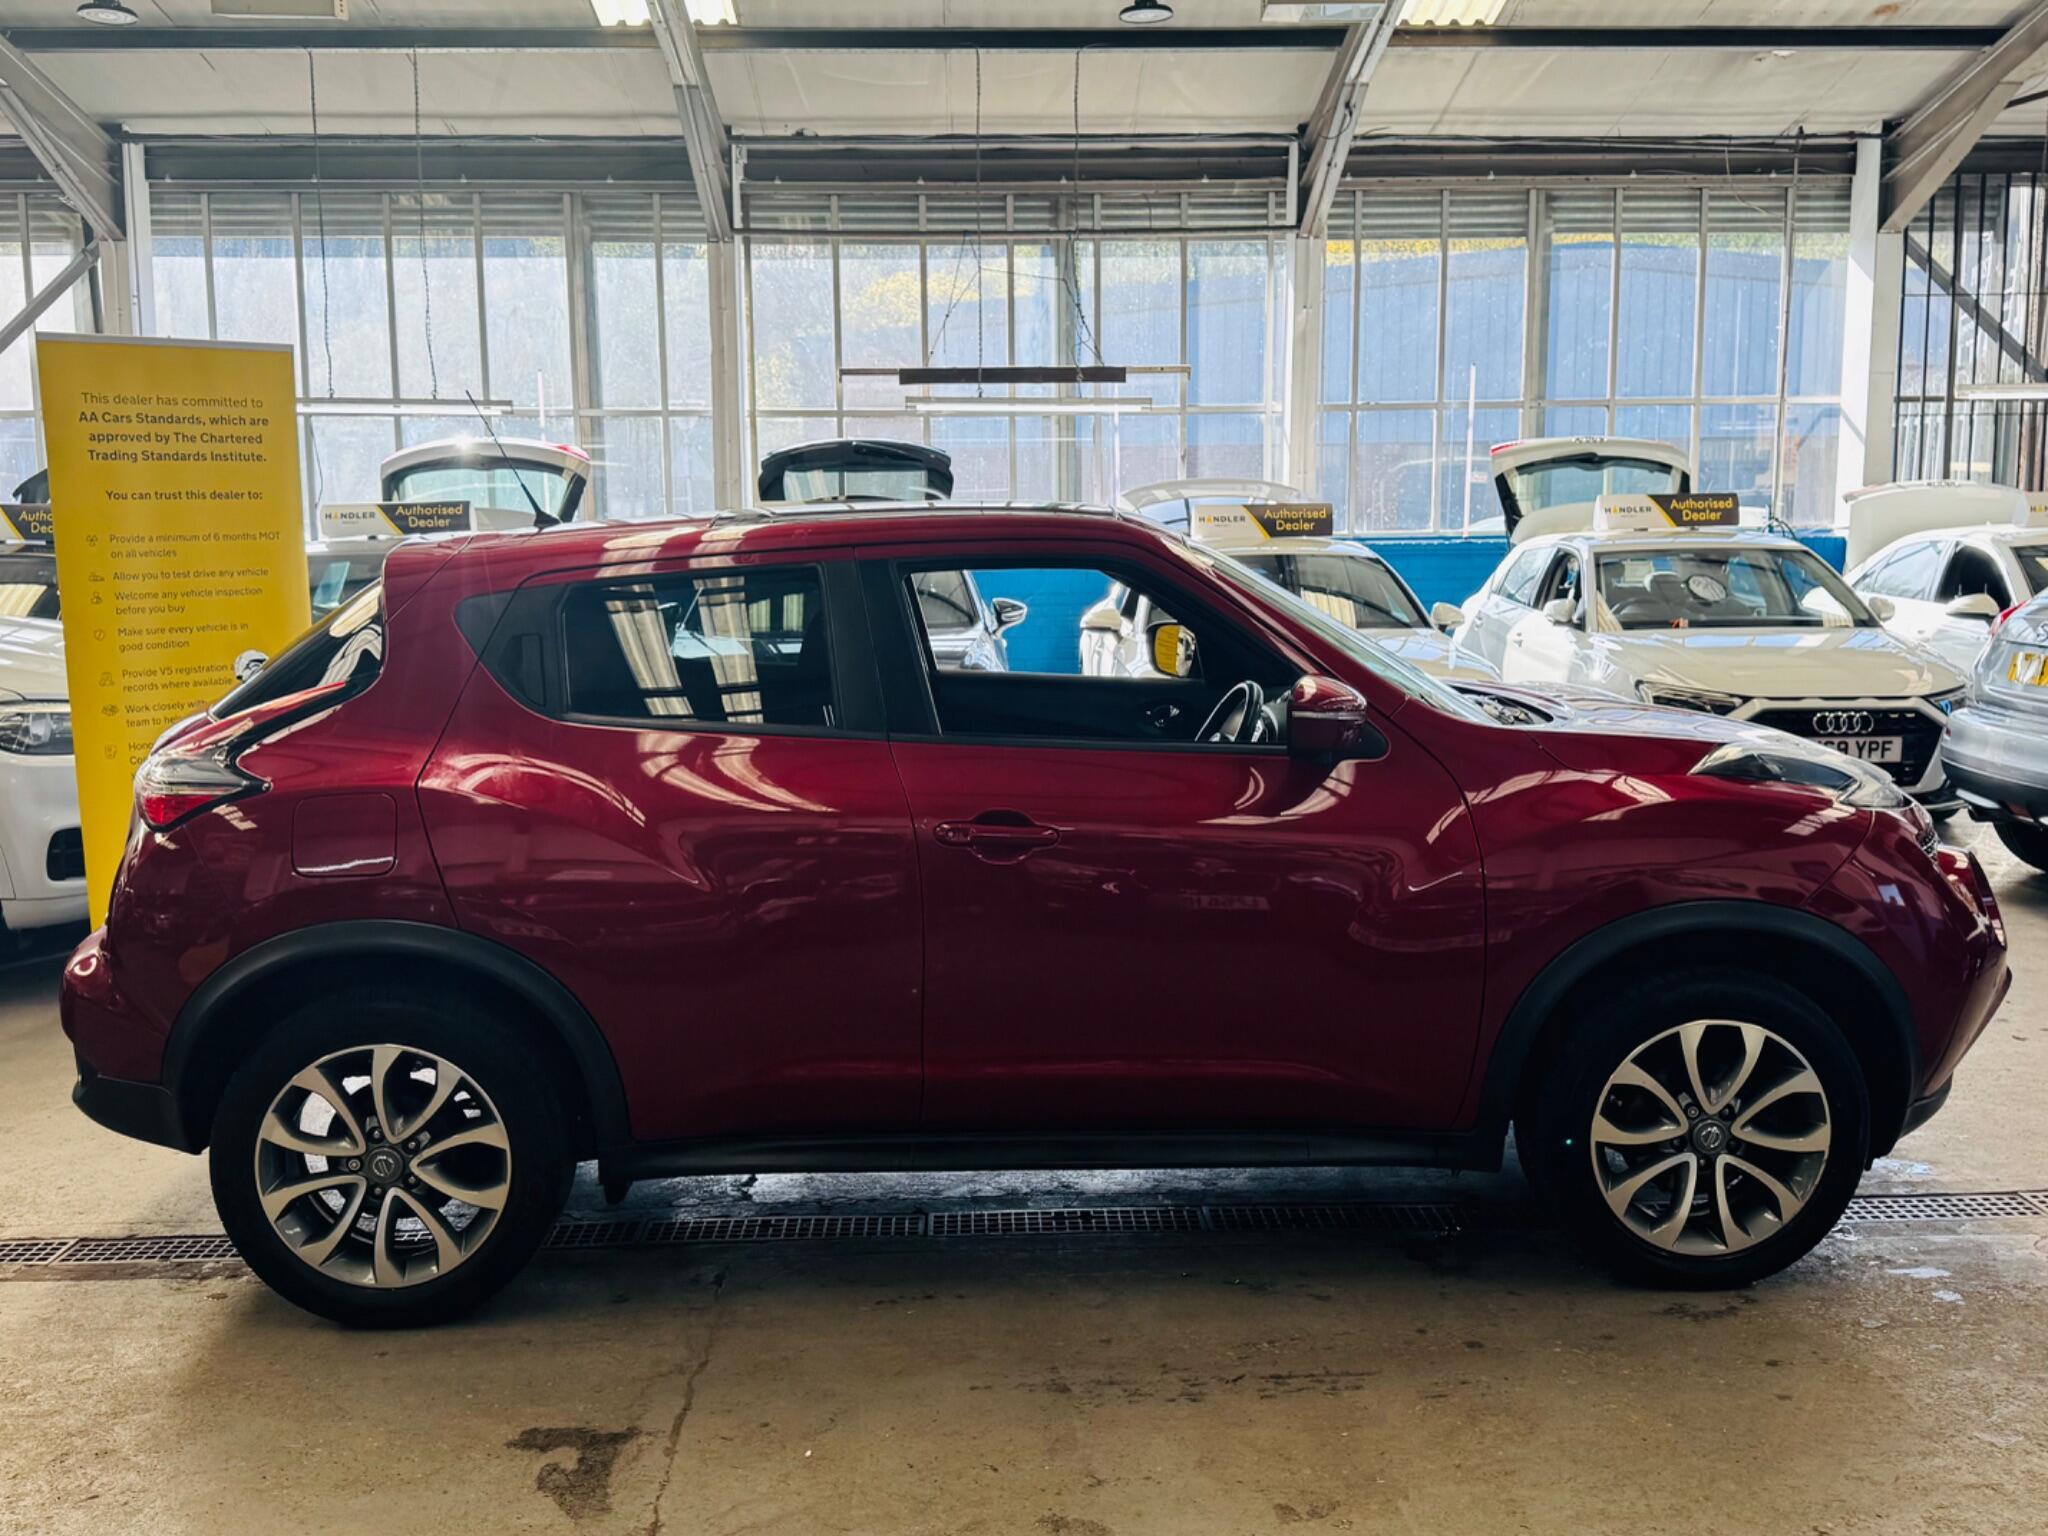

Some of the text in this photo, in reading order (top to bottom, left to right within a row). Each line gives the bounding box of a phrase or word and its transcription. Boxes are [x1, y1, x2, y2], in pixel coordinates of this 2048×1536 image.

[81, 392, 263, 408] This dealer has committed to
[79, 412, 269, 426] AA Cars Standards, which are
[89, 432, 263, 445] approved by The Chartered
[87, 450, 267, 463] Trading Standards Institute.
[105, 490, 128, 500] You
[155, 491, 182, 500] trust
[186, 490, 206, 500] this
[210, 490, 245, 500] dealer
[247, 491, 263, 500] to:
[1670, 497, 1733, 509] Authorised
[19, 511, 54, 521] Autho
[395, 504, 463, 516] Authorised
[1264, 507, 1327, 519] Authorised
[1682, 510, 1722, 521] Dealer
[408, 516, 451, 528] Dealer
[1276, 519, 1315, 531] Dealer
[110, 534, 146, 543] Provide
[156, 534, 200, 542] minimum
[202, 532, 212, 541] of
[223, 532, 257, 541] months
[259, 531, 280, 540] MOT
[111, 549, 177, 559] on all vehicles
[113, 568, 268, 582] Allow you to test drive any vehicle
[115, 587, 263, 601] Welcome any vehicle inspection
[116, 604, 185, 615] before you buy
[118, 628, 143, 637] Make
[168, 627, 193, 635] every
[196, 624, 229, 632] vehicle
[240, 622, 249, 630] in
[119, 640, 190, 652] good condition
[122, 669, 158, 679] Provide
[159, 666, 173, 675] V5
[175, 664, 227, 675] registration
[123, 678, 232, 693] records where available
[124, 703, 150, 714] Work
[152, 701, 185, 711] closely
[126, 717, 150, 728] team
[152, 717, 161, 725] to
[1855, 741, 1893, 759] YPF
